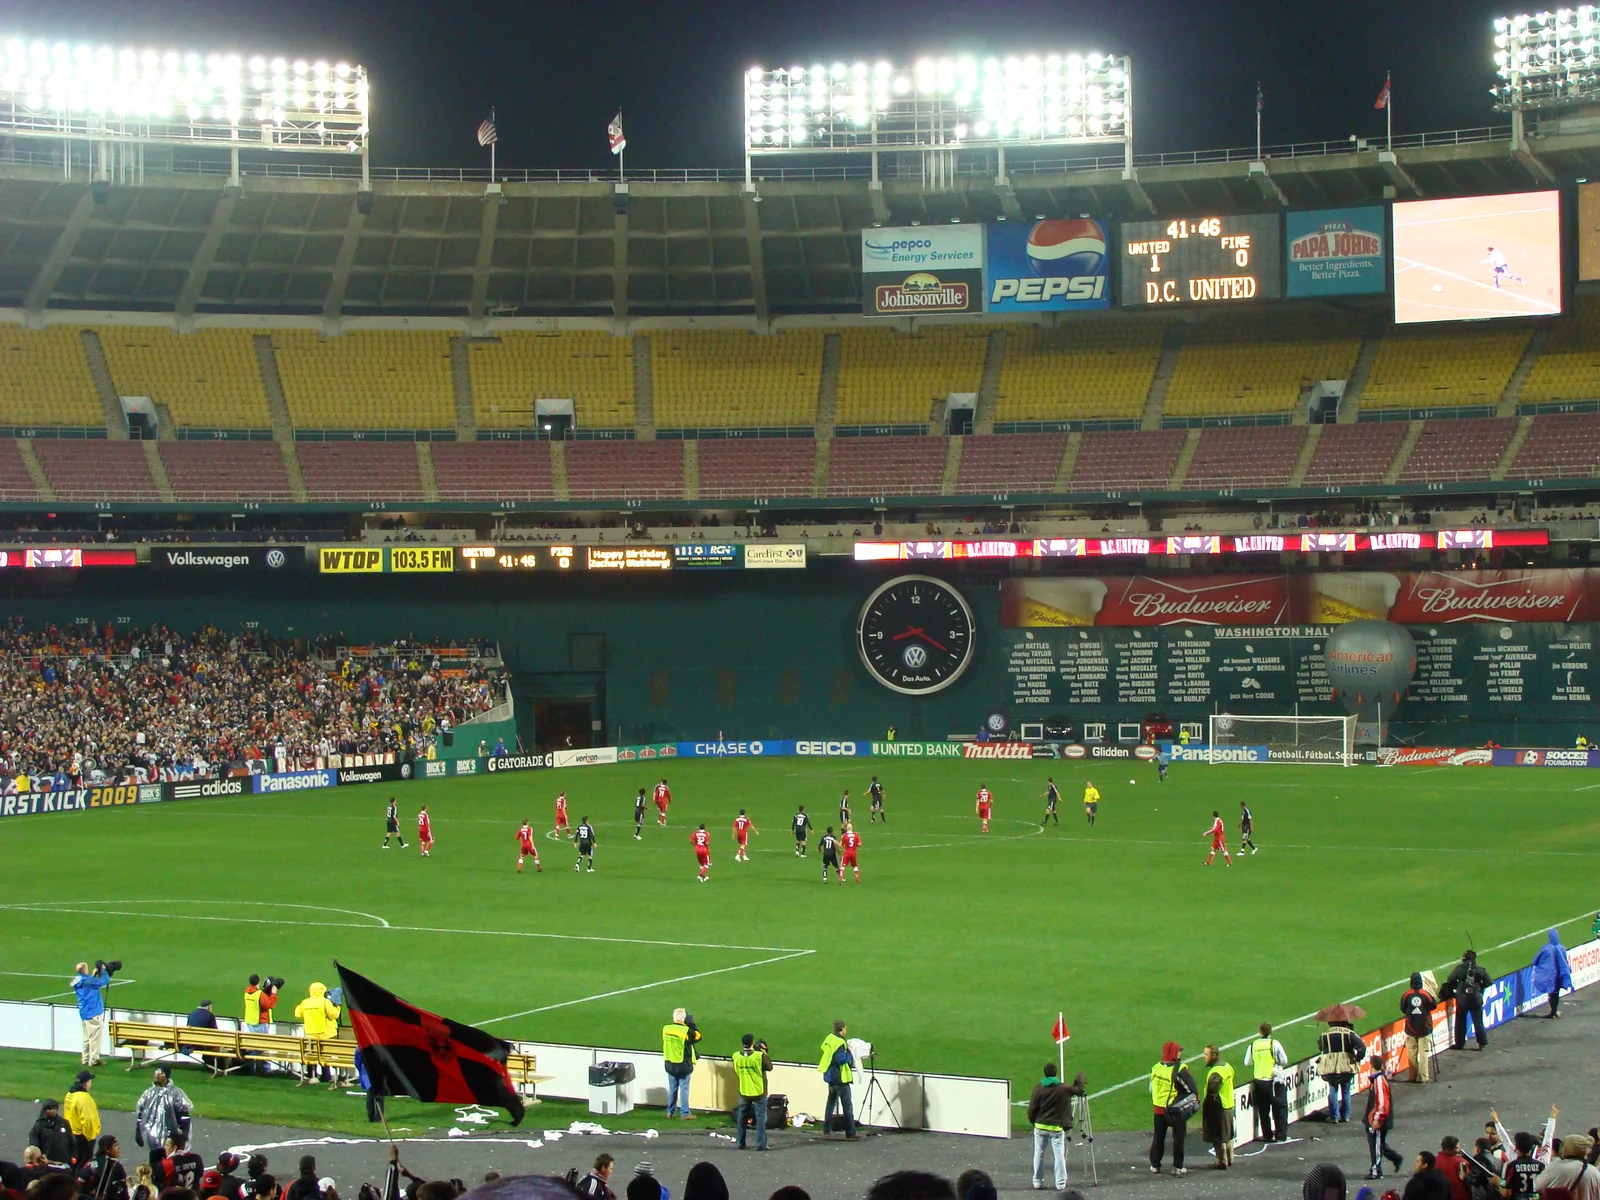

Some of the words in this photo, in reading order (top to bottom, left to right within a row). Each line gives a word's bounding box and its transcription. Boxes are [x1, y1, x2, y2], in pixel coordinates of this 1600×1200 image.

[1167, 218, 1220, 239] 41:46
[892, 240, 932, 252] pepco
[1128, 241, 1170, 255] UNITED
[1221, 236, 1250, 249] FIRE
[1293, 234, 1330, 258] PAPA
[892, 253, 927, 262] Energy
[930, 251, 974, 260] Services
[1150, 254, 1160, 272] 1
[1236, 249, 1248, 267] 0
[1300, 263, 1324, 271] Better
[1326, 260, 1374, 271] Ingredients.
[991, 276, 1106, 303] PEPSI
[1146, 280, 1180, 304] D.C.
[1189, 276, 1256, 301] UNITED
[882, 288, 962, 307] Johnsonville
[463, 548, 496, 557] UNITED
[551, 547, 574, 557] FIRE
[593, 550, 624, 560] Happy
[626, 550, 667, 559] Birthday
[710, 546, 731, 554] RCN
[167, 552, 250, 569] Volkswagen
[324, 552, 380, 569] WTOP
[393, 550, 429, 568] 103.5
[432, 551, 451, 568] FM
[499, 555, 536, 568] 41:46
[560, 557, 570, 568] 0
[1128, 592, 1272, 618] Budweiser
[1418, 588, 1564, 613] Budweiser
[1214, 628, 1300, 637] WASHINGTON
[1330, 649, 1394, 663] American
[1332, 662, 1377, 675] Airlines
[695, 743, 747, 755] CHASE
[796, 741, 856, 755] GEICO
[881, 744, 923, 755] UNITED
[926, 744, 961, 756] BANK
[1092, 747, 1129, 757] Glidden
[1171, 745, 1257, 761] Panasonic
[1268, 750, 1304, 759] Football.
[576, 753, 598, 763] verizon
[1378, 748, 1456, 764] Budweiser
[1546, 751, 1589, 759] SOCCER
[498, 756, 543, 769] GATORADE
[260, 771, 329, 792] Panasonic
[340, 771, 381, 782] Volkswagen
[202, 780, 242, 796] adidas
[44, 789, 88, 812] KICK
[91, 785, 138, 806] 2009
[580, 830, 588, 838] 99
[696, 837, 705, 845] 32
[849, 838, 854, 847] 5
[1520, 1173, 1537, 1192] 31
